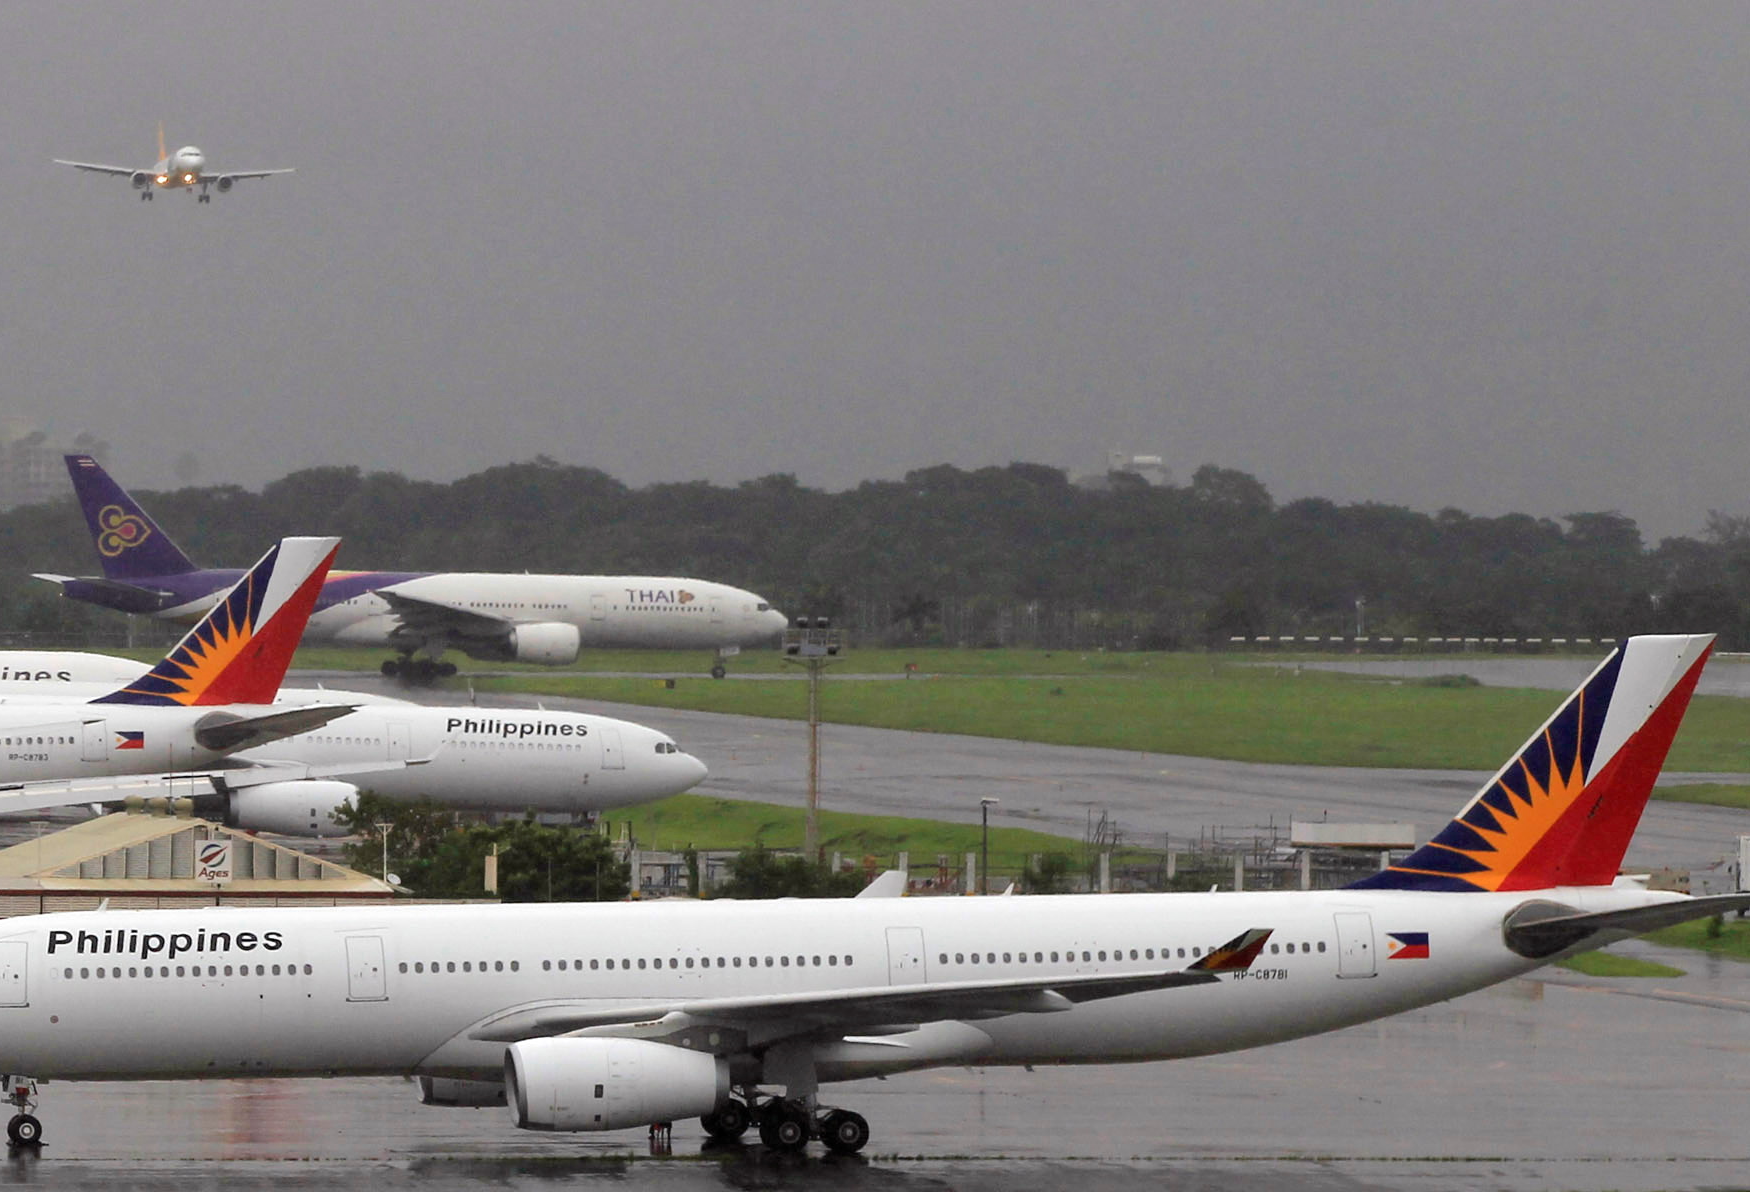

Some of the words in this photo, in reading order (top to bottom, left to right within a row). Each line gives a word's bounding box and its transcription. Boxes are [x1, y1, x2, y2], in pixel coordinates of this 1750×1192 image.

[625, 588, 674, 604] THAI
[446, 718, 588, 739] Philippines
[198, 867, 230, 881] Ages
[47, 928, 284, 960] Philippines
